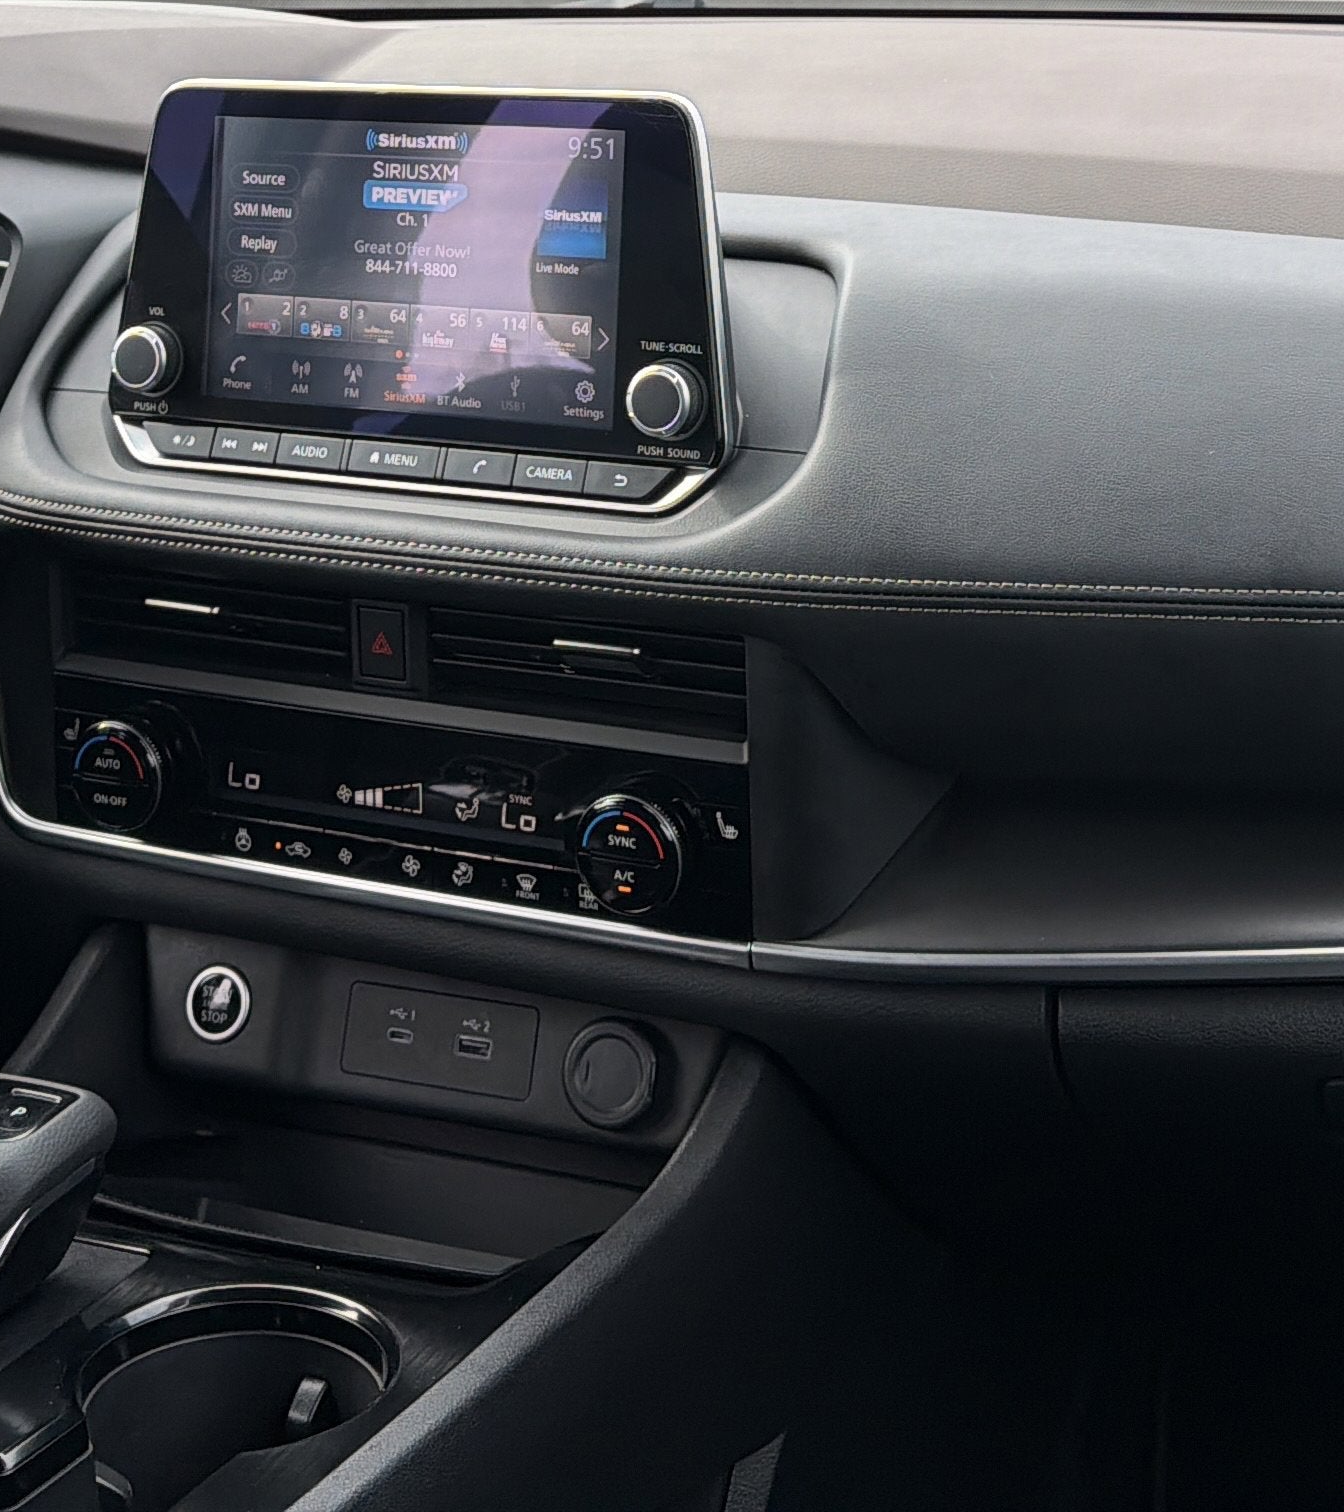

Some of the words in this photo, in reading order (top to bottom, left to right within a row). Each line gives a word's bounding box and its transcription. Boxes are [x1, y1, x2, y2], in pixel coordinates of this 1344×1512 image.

[568, 136, 616, 161] 9:51
[242, 170, 286, 186] Source
[373, 161, 459, 181] SIRIUSXM
[371, 187, 458, 205] PREVIEW
[233, 201, 258, 217] SXM
[260, 203, 292, 219] Menu
[396, 212, 418, 227] Ch.
[422, 213, 429, 227] 1
[240, 234, 277, 254] Replay
[354, 239, 392, 255] Great
[394, 241, 430, 257] Offer
[434, 242, 471, 259] Now!
[365, 259, 457, 278] 844-711-8800
[535, 262, 553, 274] Live
[554, 263, 580, 276] Mode
[148, 306, 165, 317] VOL
[282, 301, 291, 316] 2
[299, 304, 307, 316] 2
[339, 305, 349, 320] 8
[357, 308, 365, 320] 3
[389, 309, 407, 324] 64
[416, 313, 424, 324] 4
[449, 313, 467, 328] 56
[476, 318, 483, 328] 5
[504, 316, 527, 332] 114
[537, 320, 544, 331] 6
[571, 321, 590, 336] 64
[222, 377, 252, 390] Phone
[291, 384, 309, 394] AM
[344, 388, 359, 399] FM
[384, 390, 426, 405] SiriusXM
[133, 400, 157, 412] PUSH
[437, 397, 451, 407] BT
[452, 398, 482, 410] Audio
[563, 404, 605, 421] Settings
[291, 444, 328, 459] AUDIO
[637, 445, 664, 457] PUSH
[667, 447, 701, 460] SOUND
[384, 452, 418, 467] MENU
[525, 465, 573, 481] CAMERA
[94, 757, 121, 771] AUTO
[228, 761, 261, 790] Lo
[508, 792, 533, 806] SYNC
[501, 802, 537, 832] Lo
[607, 834, 637, 850] SYNC
[613, 868, 635, 884] A/C
[515, 889, 541, 901] FRONT
[578, 899, 599, 911] REAR
[201, 1009, 228, 1024] STOP
[483, 1020, 491, 1033] 2
[9, 1106, 27, 1117] P
